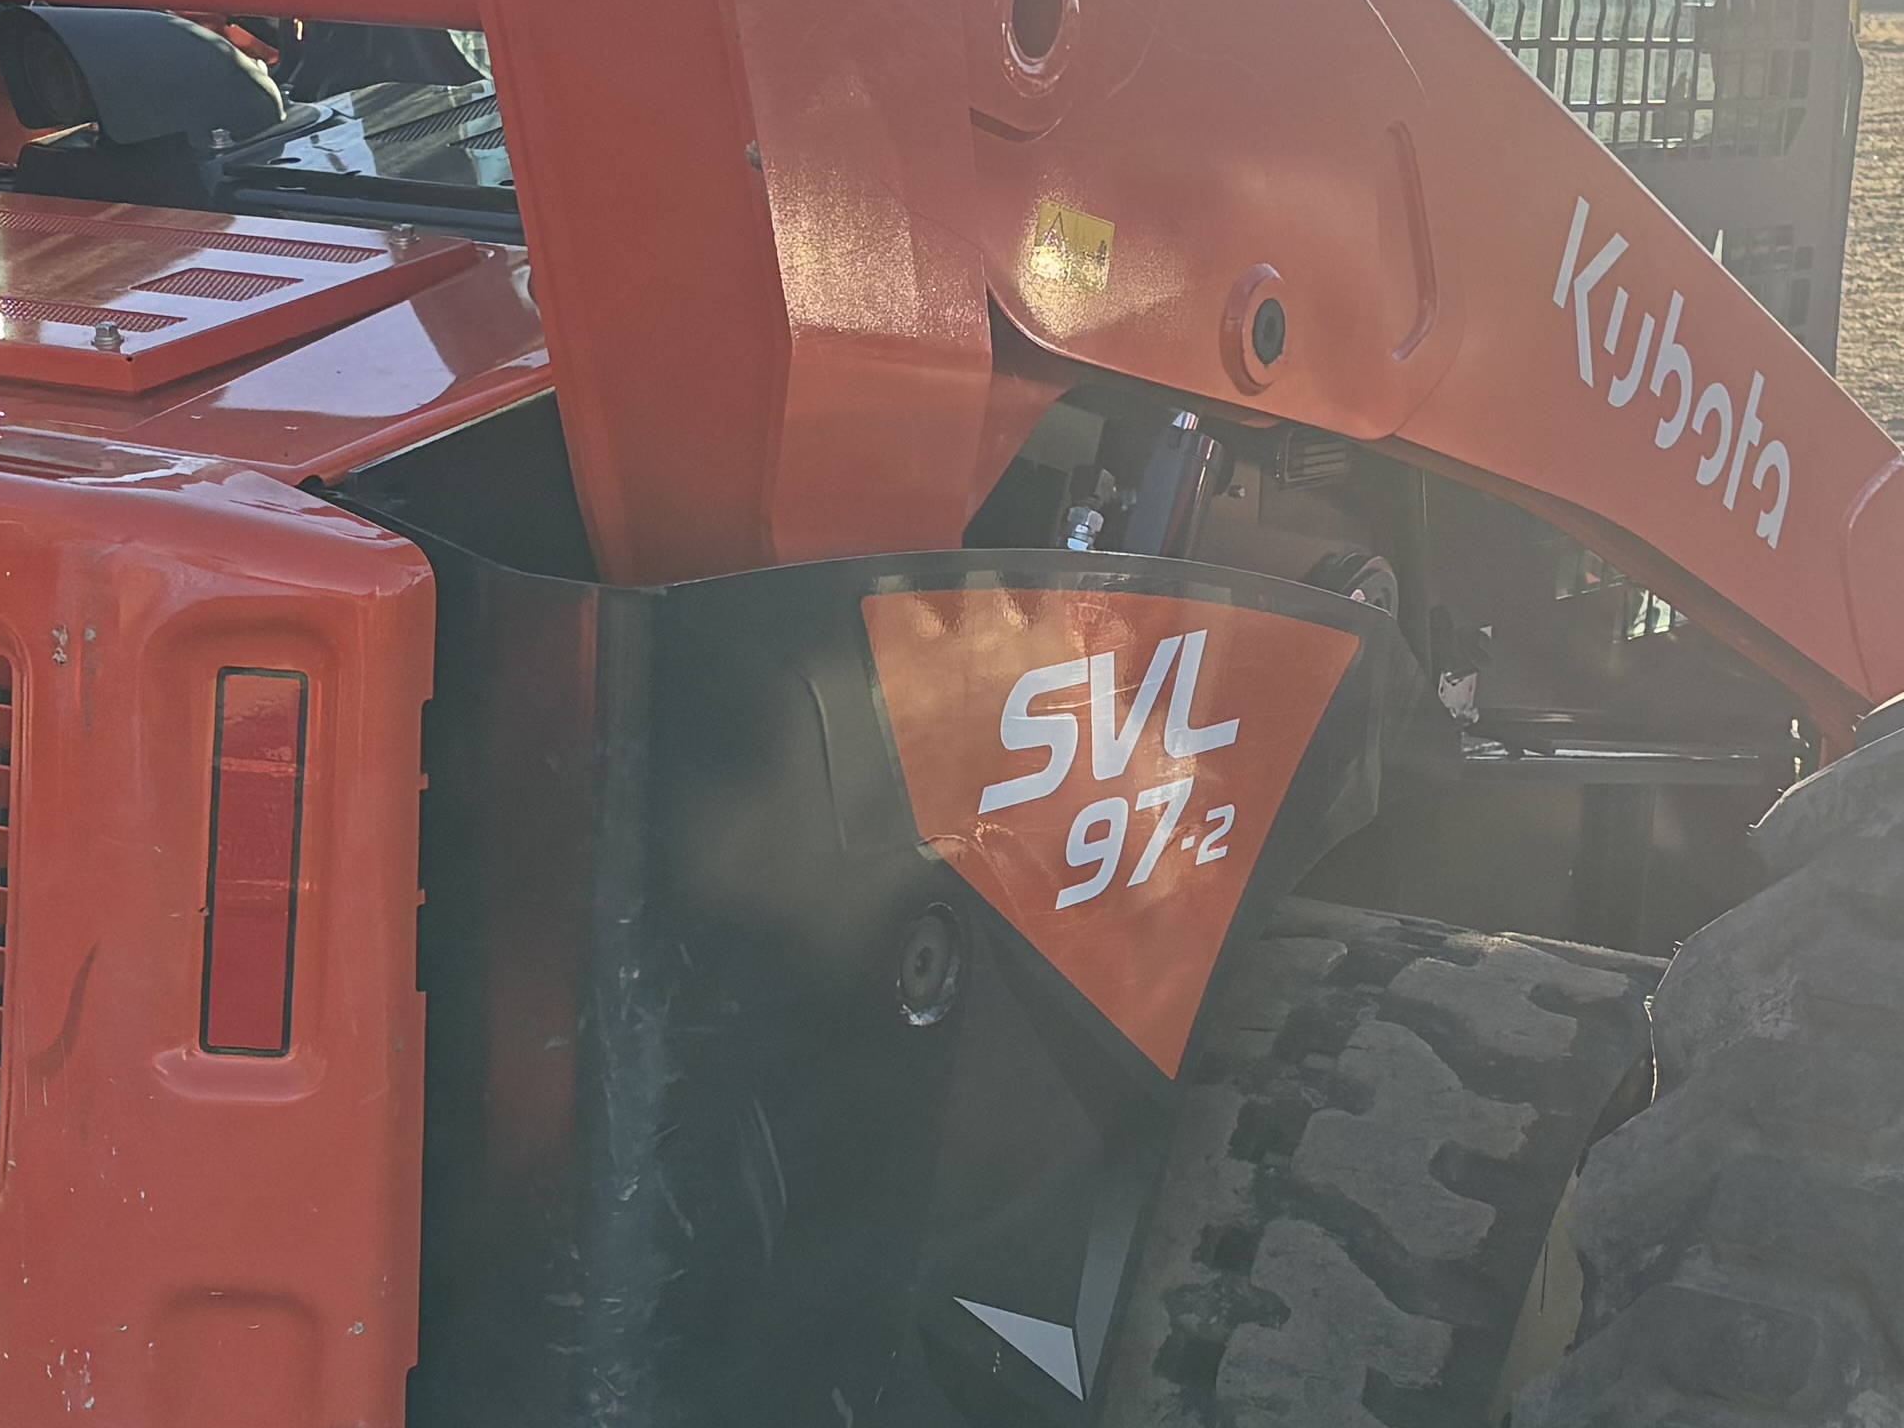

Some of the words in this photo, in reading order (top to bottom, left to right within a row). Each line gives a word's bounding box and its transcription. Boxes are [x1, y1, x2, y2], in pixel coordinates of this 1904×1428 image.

[1553, 196, 1791, 550] Kubota
[978, 629, 1240, 814] SVL
[1055, 776, 1236, 910] 97-2
